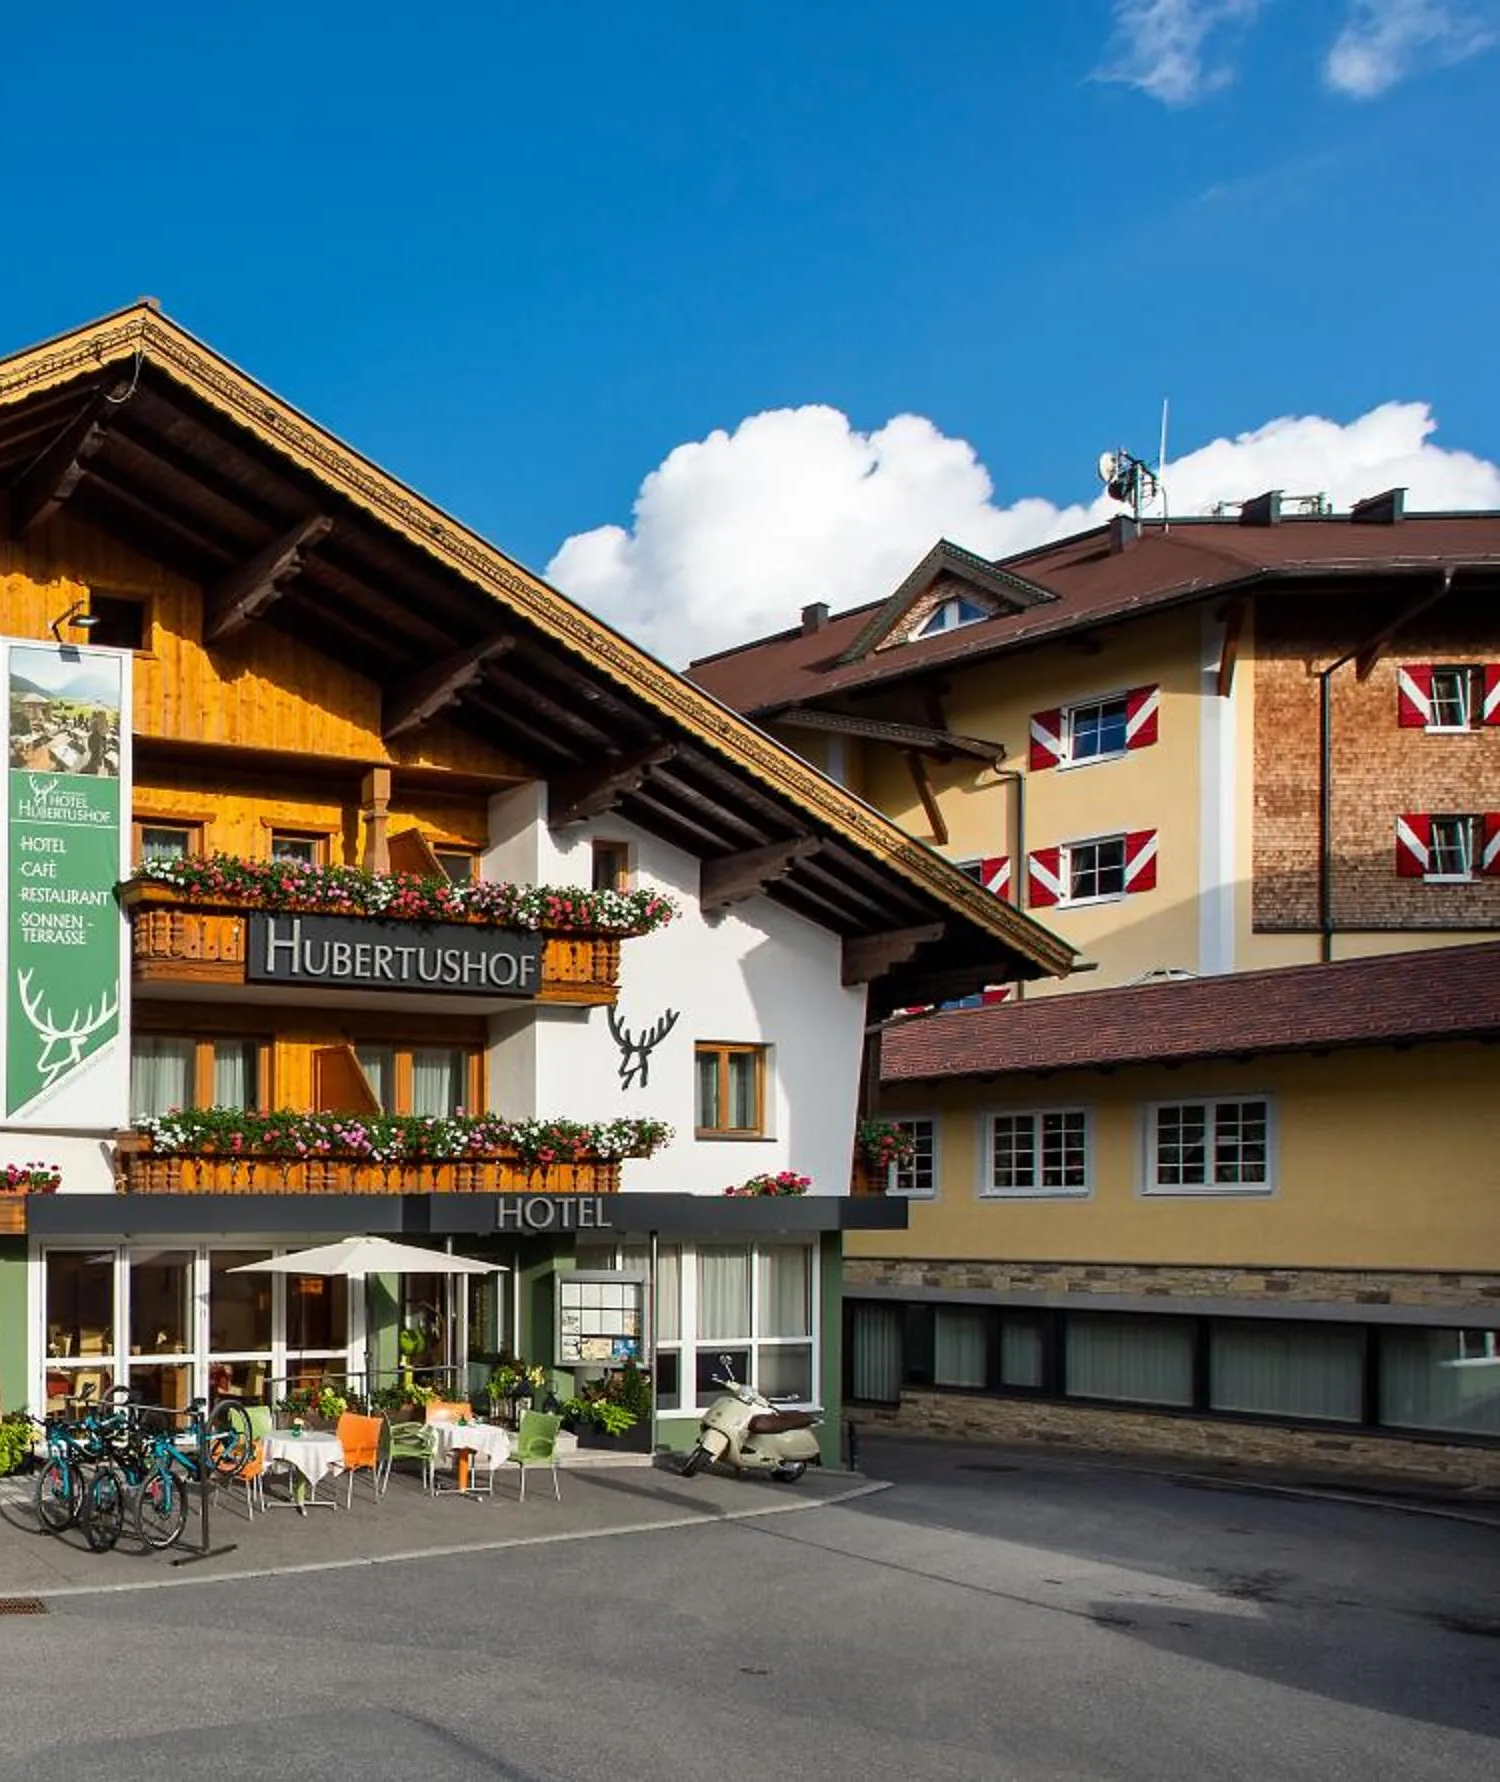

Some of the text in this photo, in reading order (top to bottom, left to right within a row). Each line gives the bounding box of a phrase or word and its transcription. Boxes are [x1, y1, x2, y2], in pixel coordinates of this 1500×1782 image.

[19, 799, 111, 823] HUBERTUSHOF
[49, 795, 89, 809] HOTEL
[20, 836, 68, 853] HOTEL
[20, 886, 111, 906] RESTAURANT
[22, 928, 88, 946] TERRASSE
[266, 918, 536, 988] HUBERTUSHOF
[497, 1196, 613, 1229] HOTEL
